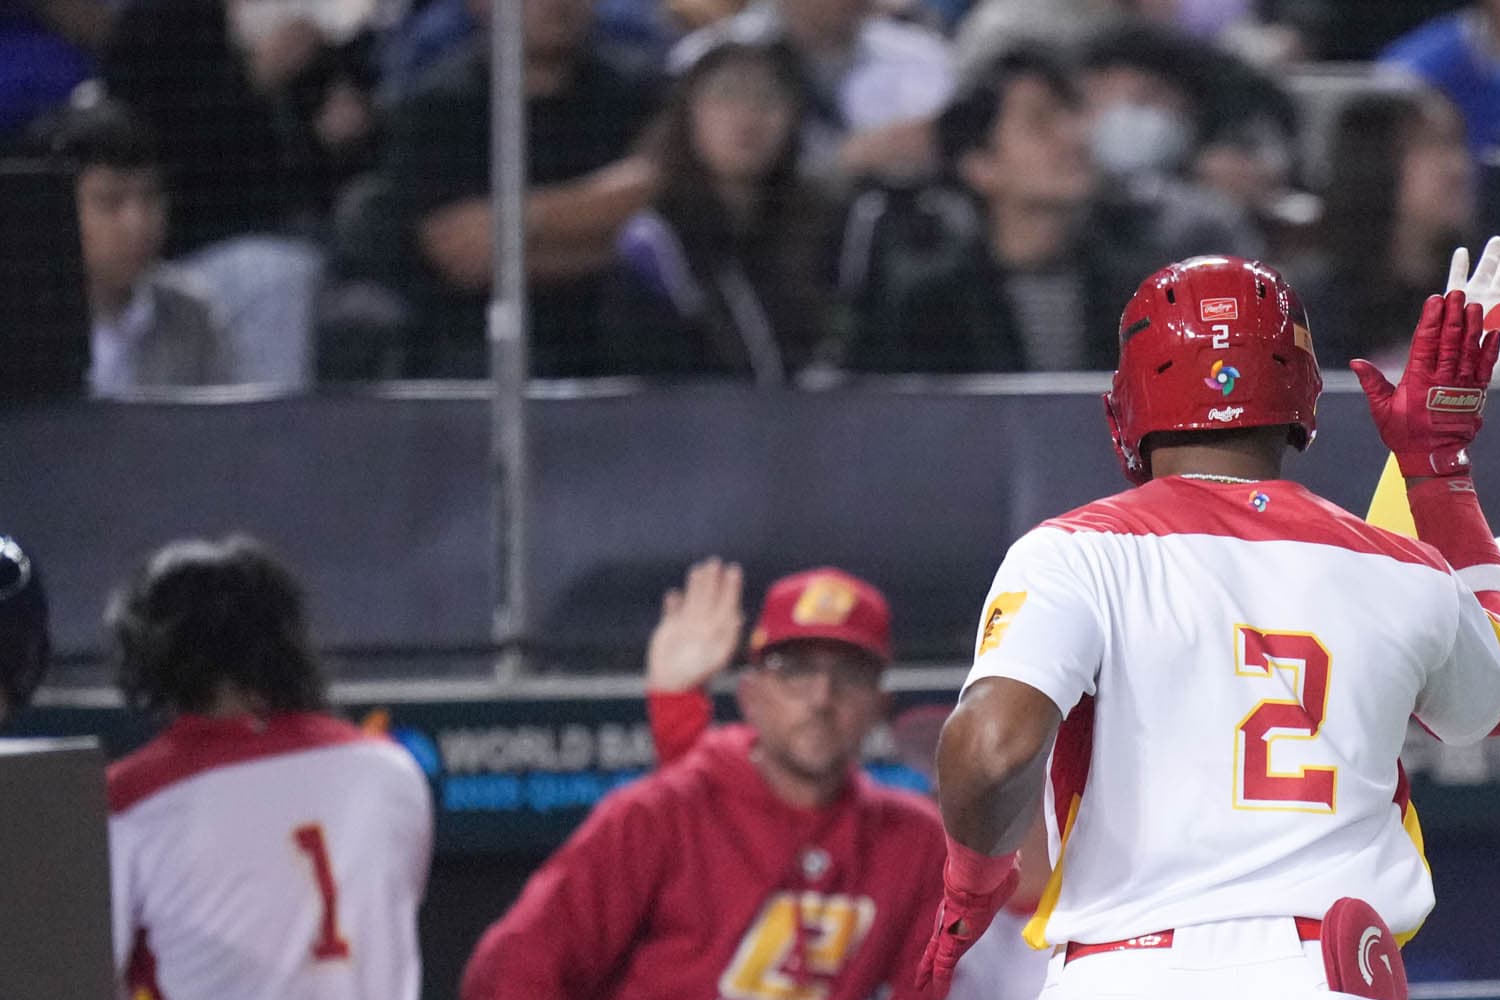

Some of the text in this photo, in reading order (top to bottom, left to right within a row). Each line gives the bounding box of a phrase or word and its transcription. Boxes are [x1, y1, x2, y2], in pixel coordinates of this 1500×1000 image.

[1211, 324, 1230, 349] 2
[1233, 622, 1337, 814] 2
[292, 822, 350, 962] 1
